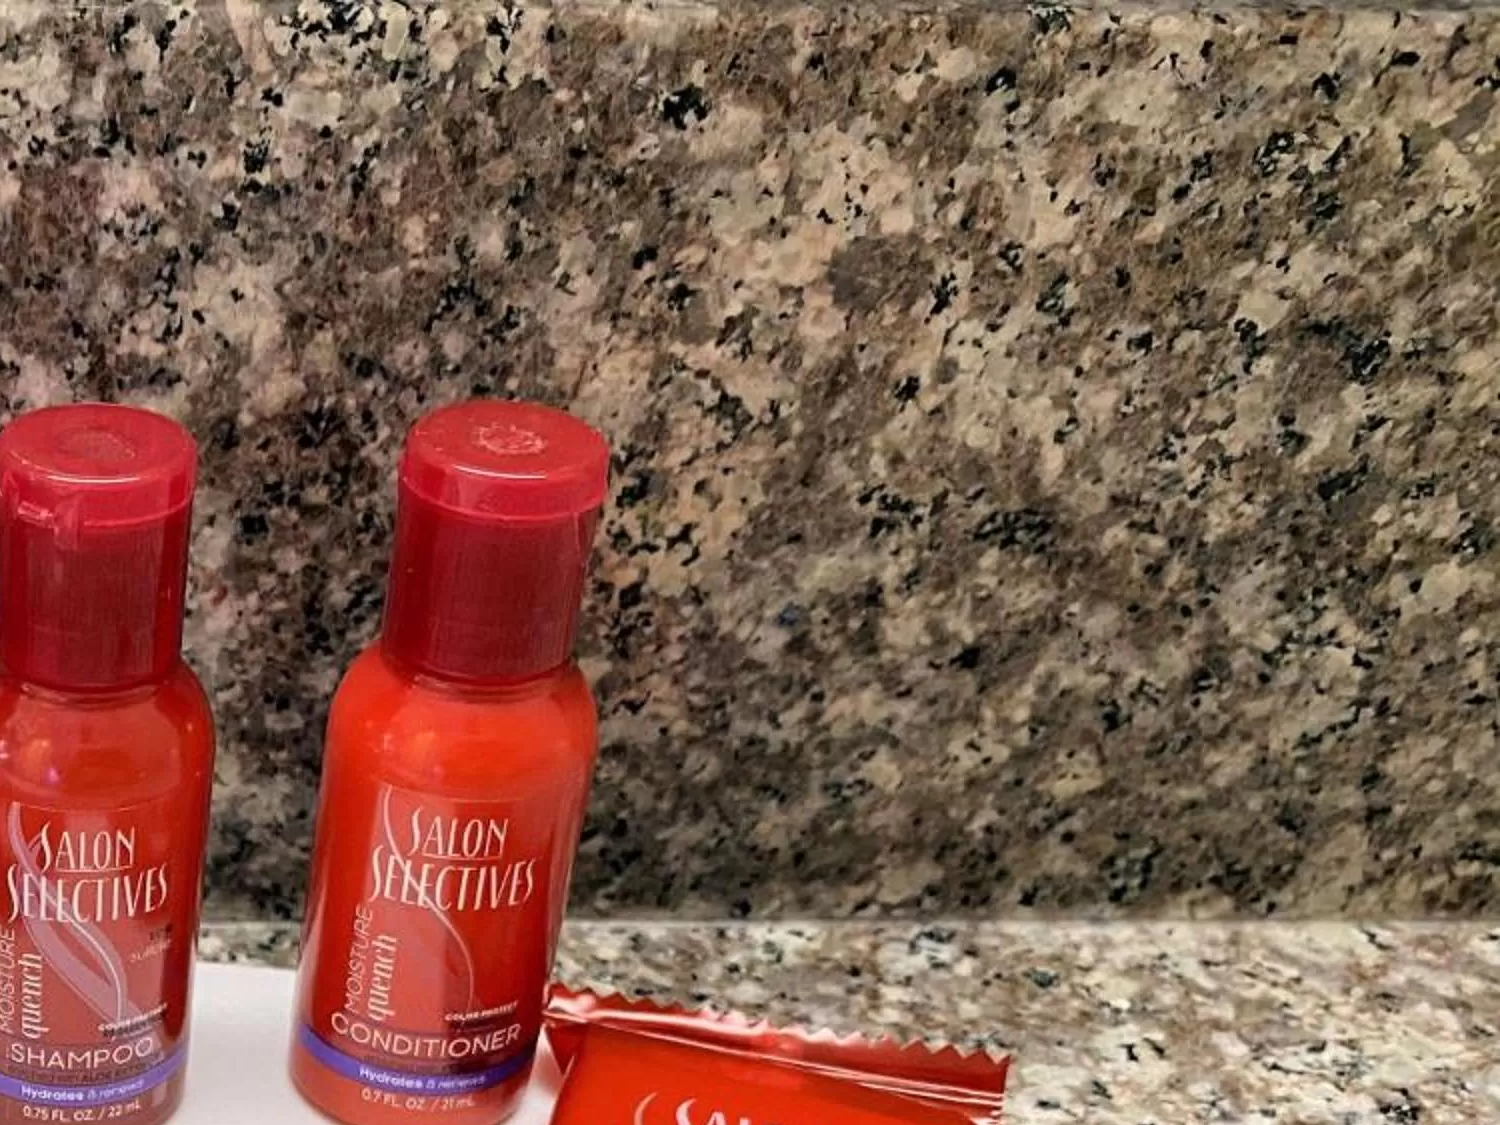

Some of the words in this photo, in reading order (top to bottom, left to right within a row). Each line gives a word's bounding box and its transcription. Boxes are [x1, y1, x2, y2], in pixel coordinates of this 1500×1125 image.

[40, 822, 136, 873] SALON
[411, 806, 509, 857] SALON
[7, 863, 168, 923] SELECTIVES
[369, 844, 536, 912] SELECTIVES
[344, 904, 373, 1015] MOISTURE
[368, 934, 397, 1021] quench
[20, 953, 49, 1039] quench
[11, 1037, 153, 1069] SHAMPOO
[331, 1012, 521, 1057] CONDITIONER
[21, 1085, 85, 1101] Hydrates
[359, 1067, 423, 1089] Hydrates
[23, 1106, 49, 1121] 0.75
[52, 1109, 71, 1122] FL.
